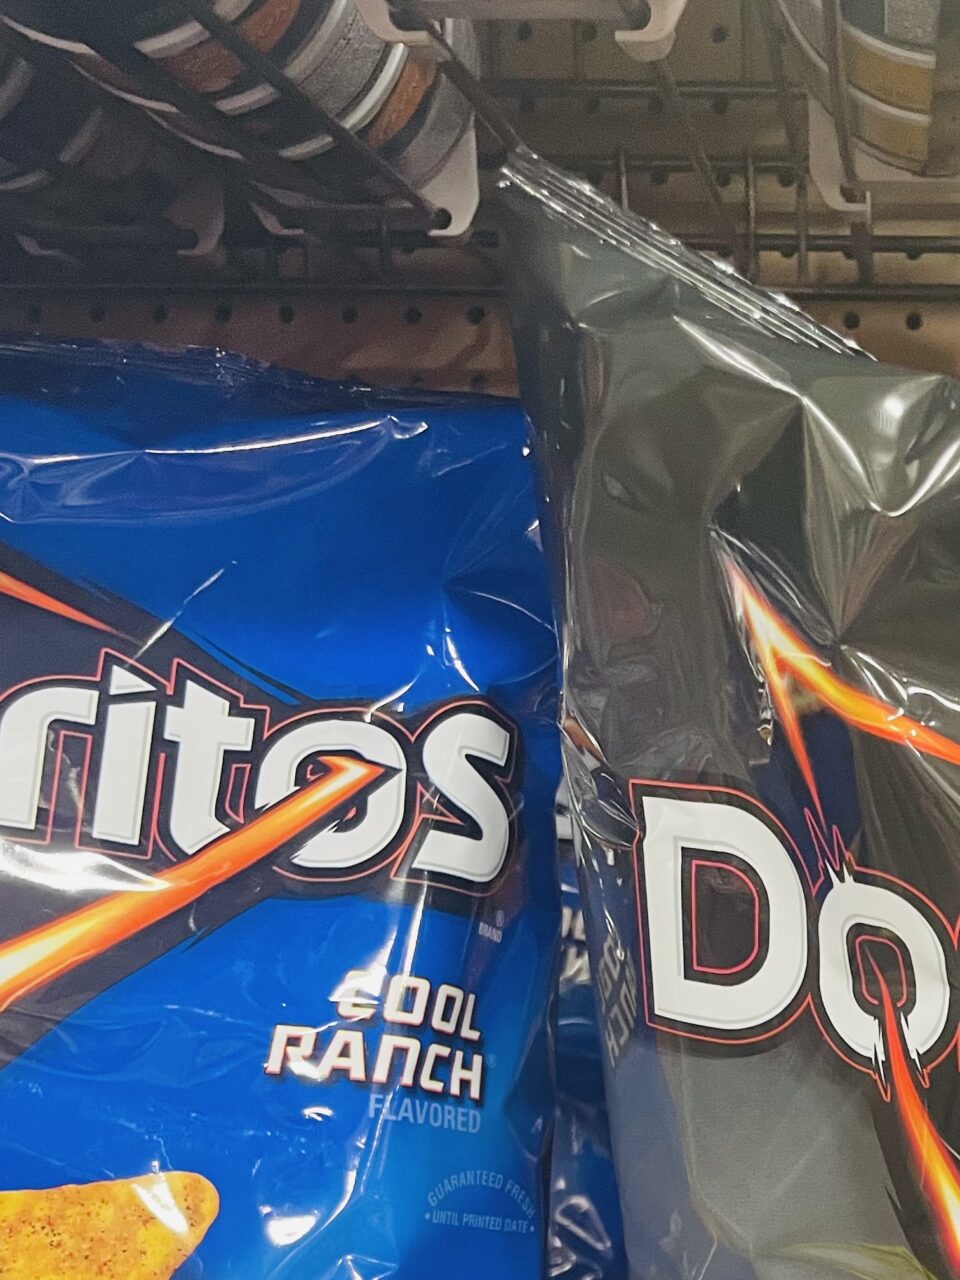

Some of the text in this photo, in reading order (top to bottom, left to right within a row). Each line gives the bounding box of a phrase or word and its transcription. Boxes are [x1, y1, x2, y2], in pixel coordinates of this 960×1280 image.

[335, 969, 482, 1042] COOL
[264, 1023, 484, 1101] RANCH
[368, 1093, 482, 1135] FLAVORED
[426, 1169, 537, 1219] GUARANTEED FRESH
[431, 1209, 529, 1233] UNTIL PRINTED DATE
